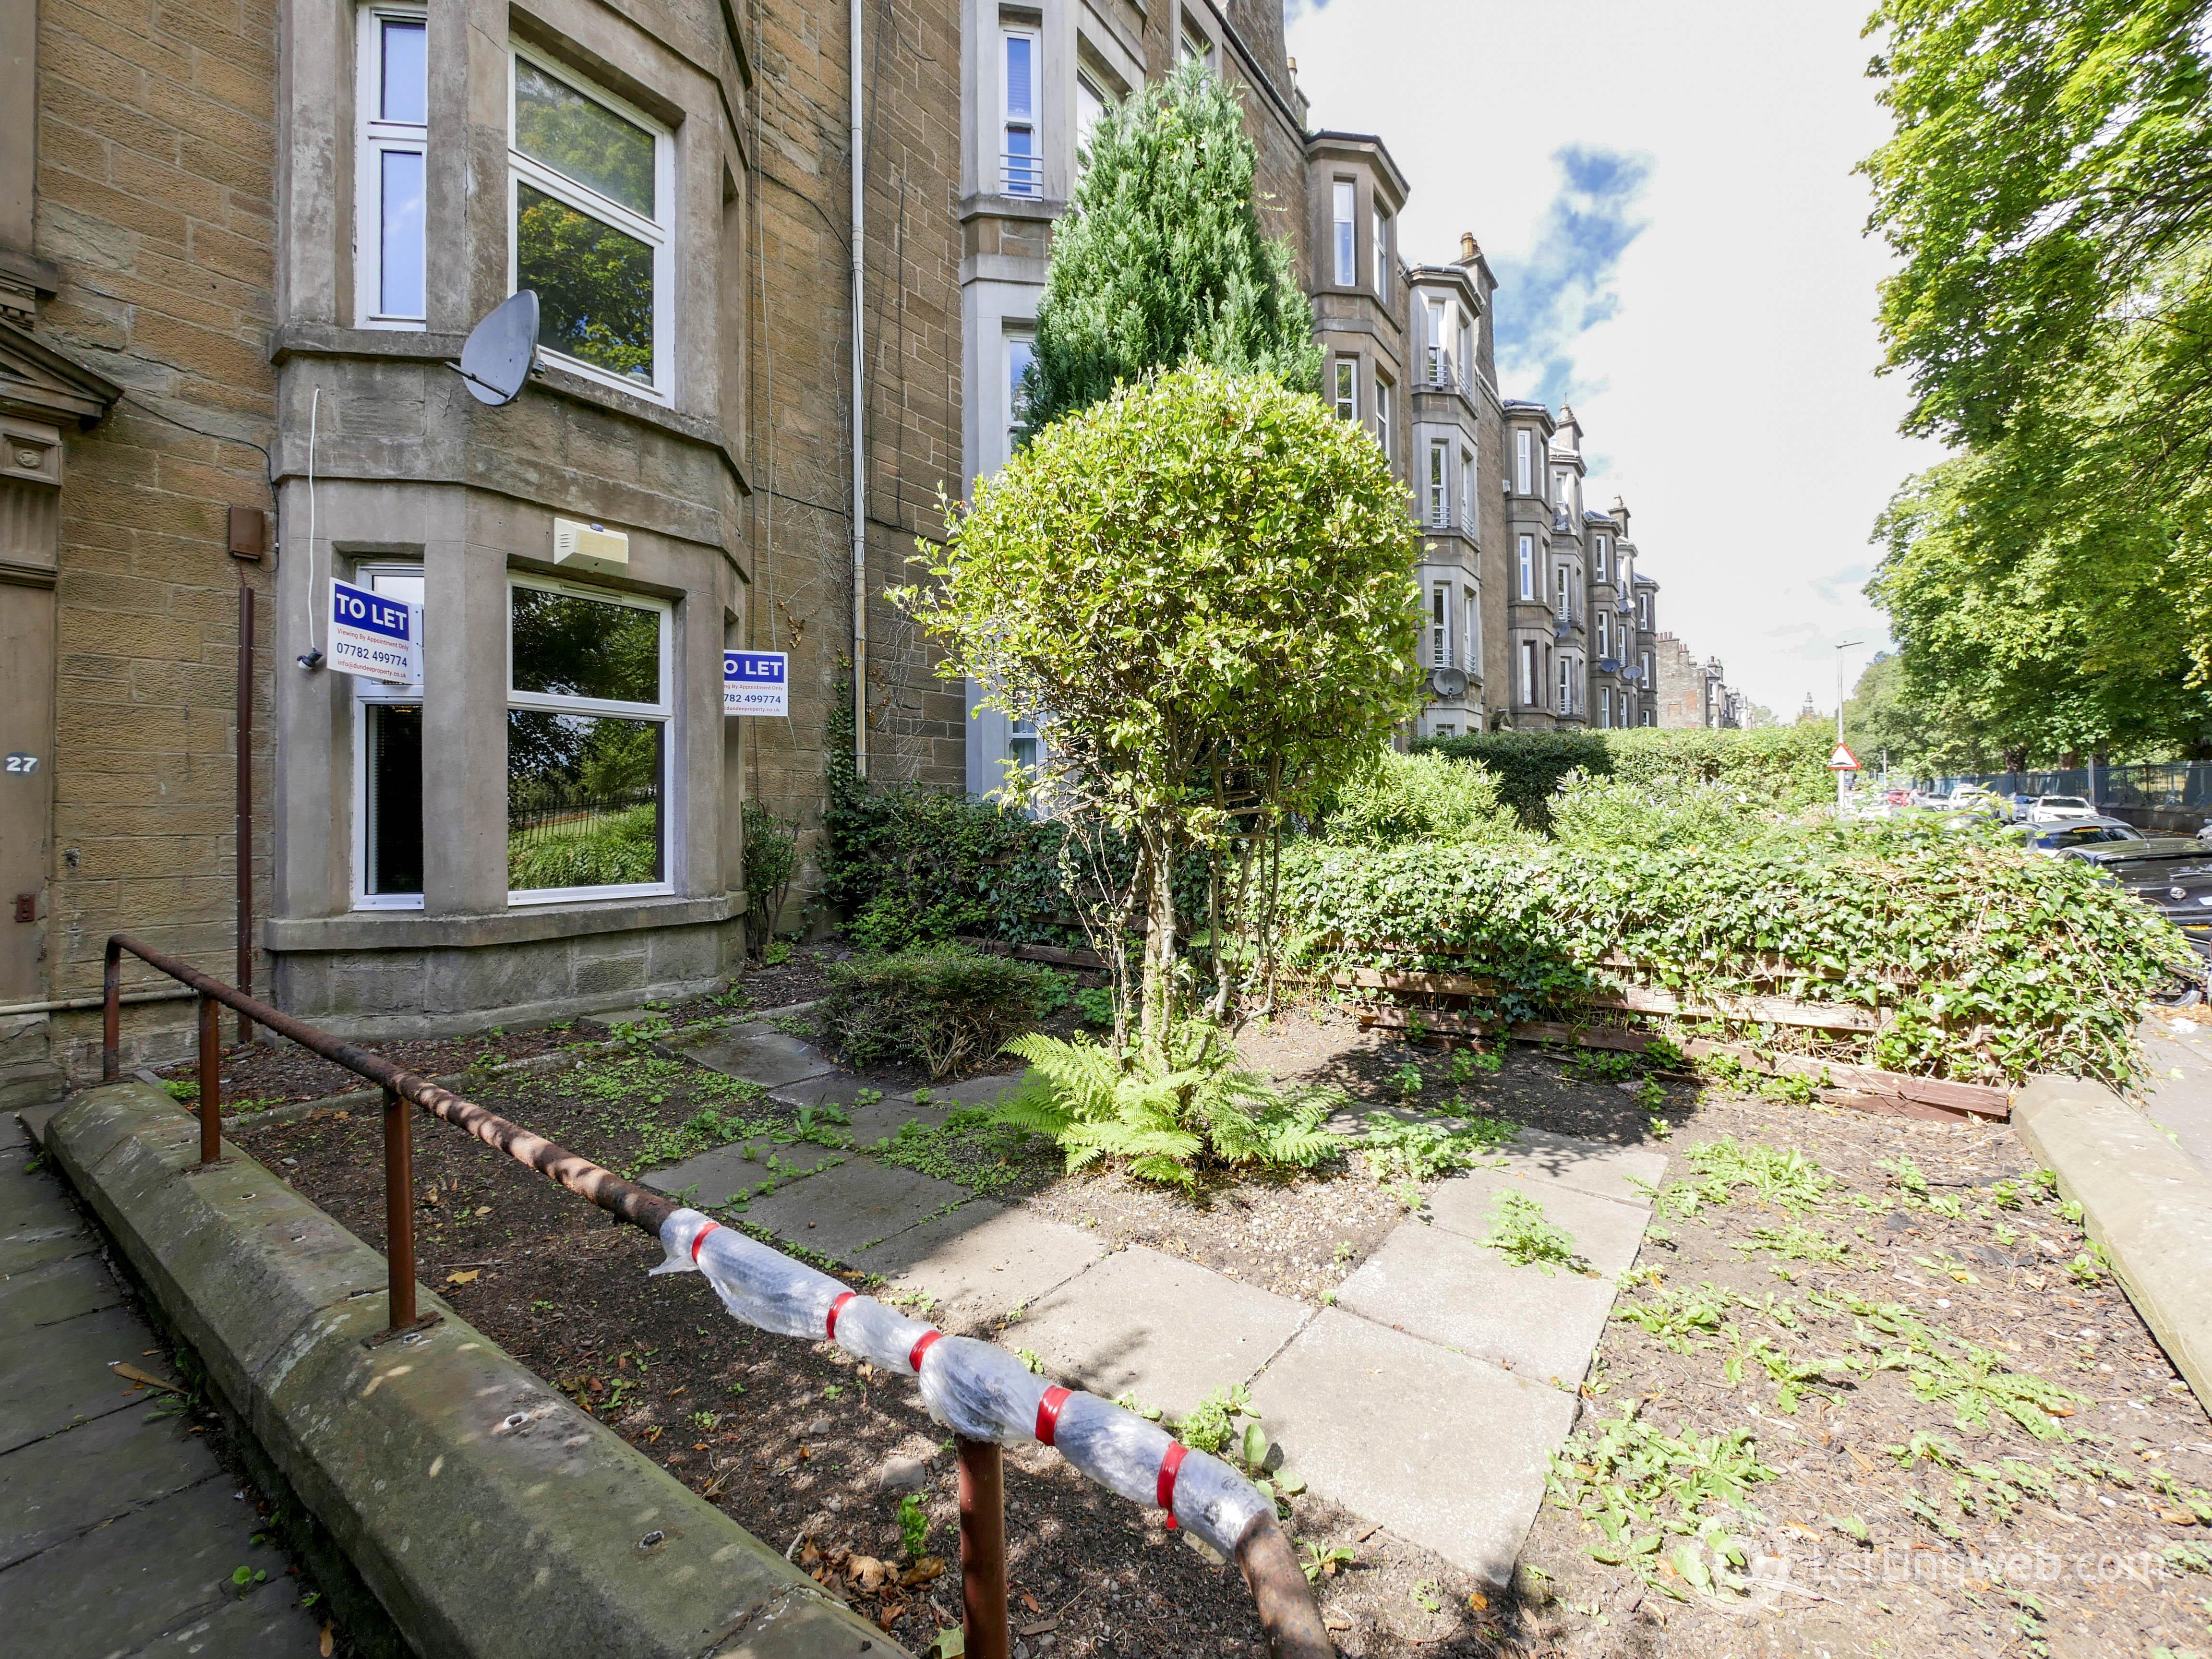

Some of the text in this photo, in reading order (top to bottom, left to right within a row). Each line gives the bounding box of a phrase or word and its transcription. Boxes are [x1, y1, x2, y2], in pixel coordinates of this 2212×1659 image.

[337, 593, 407, 630] TO LET
[337, 628, 358, 639] Viewing
[367, 636, 397, 648] Appointment
[399, 643, 409, 651] Only
[337, 642, 408, 667] 07782 499774
[338, 659, 407, 678] info@dundeeproperty.co.uk
[724, 660, 782, 676] O LET
[724, 694, 781, 704] 782 499774
[6, 757, 37, 772] 27
